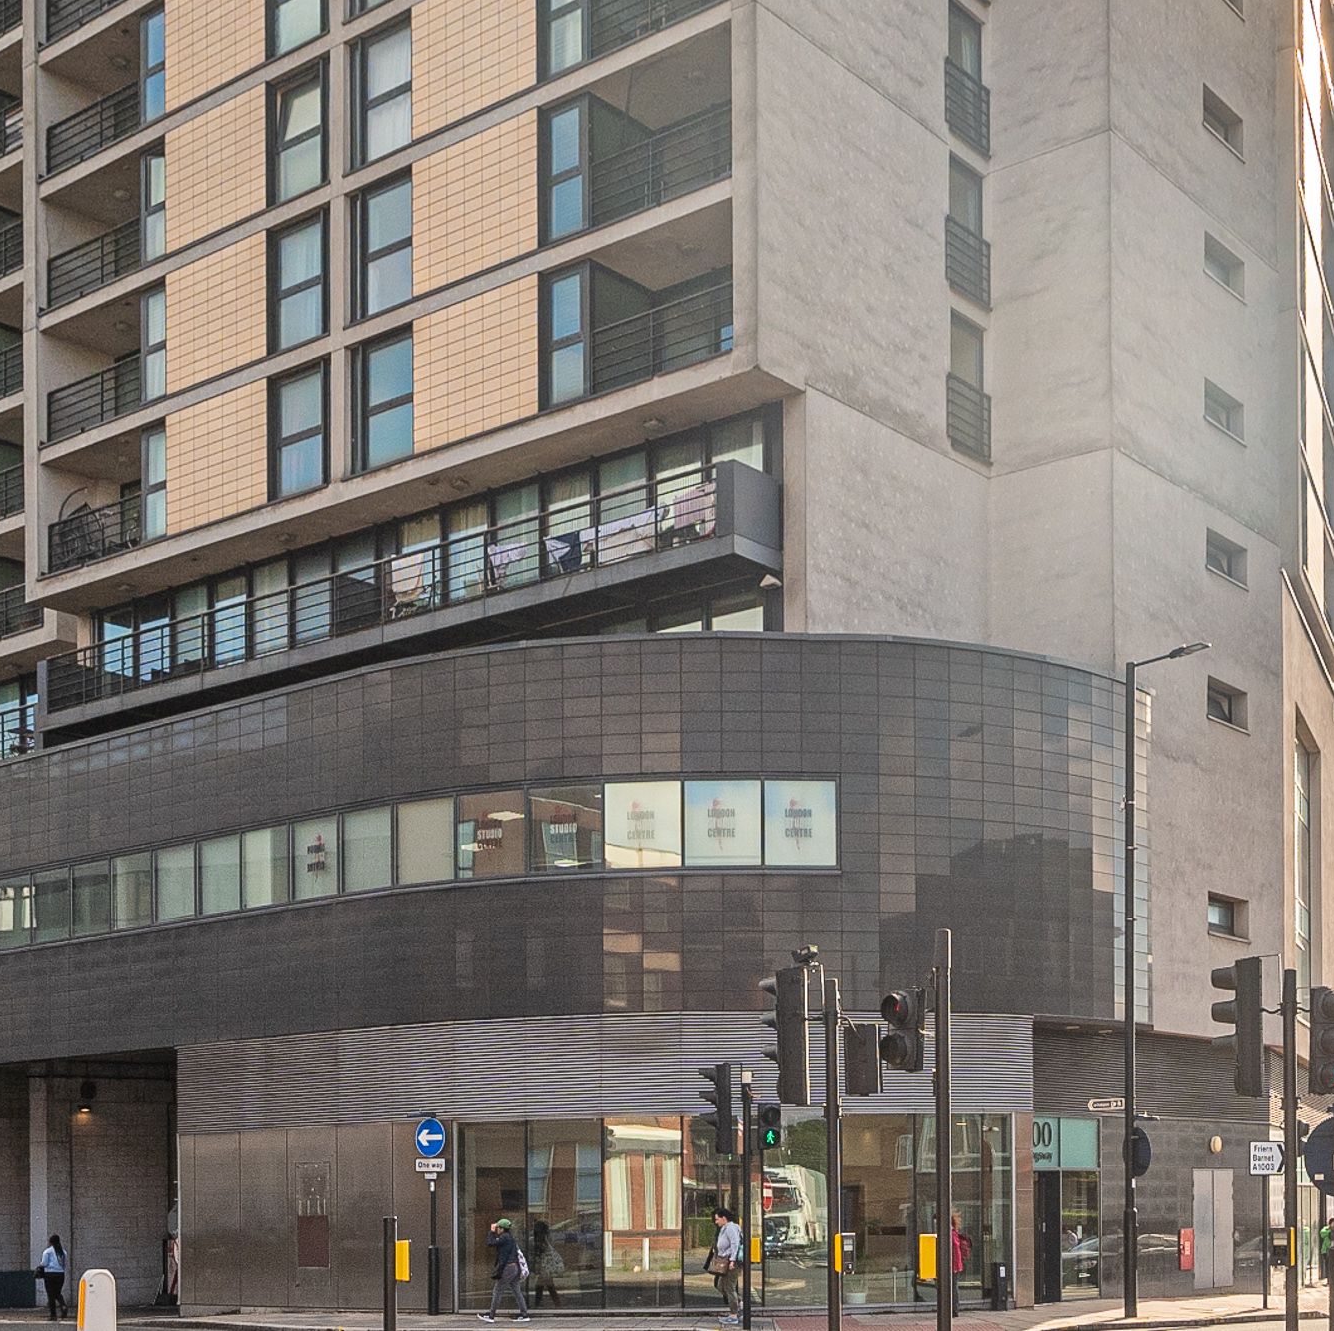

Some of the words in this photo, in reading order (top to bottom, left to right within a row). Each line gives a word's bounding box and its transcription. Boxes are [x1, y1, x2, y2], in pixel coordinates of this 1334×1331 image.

[550, 823, 577, 834] STUDIO
[477, 828, 502, 840] STUDIO
[1252, 1154, 1274, 1162] Barnet
[417, 1161, 430, 1169] One
[1252, 1163, 1275, 1171] A1003
